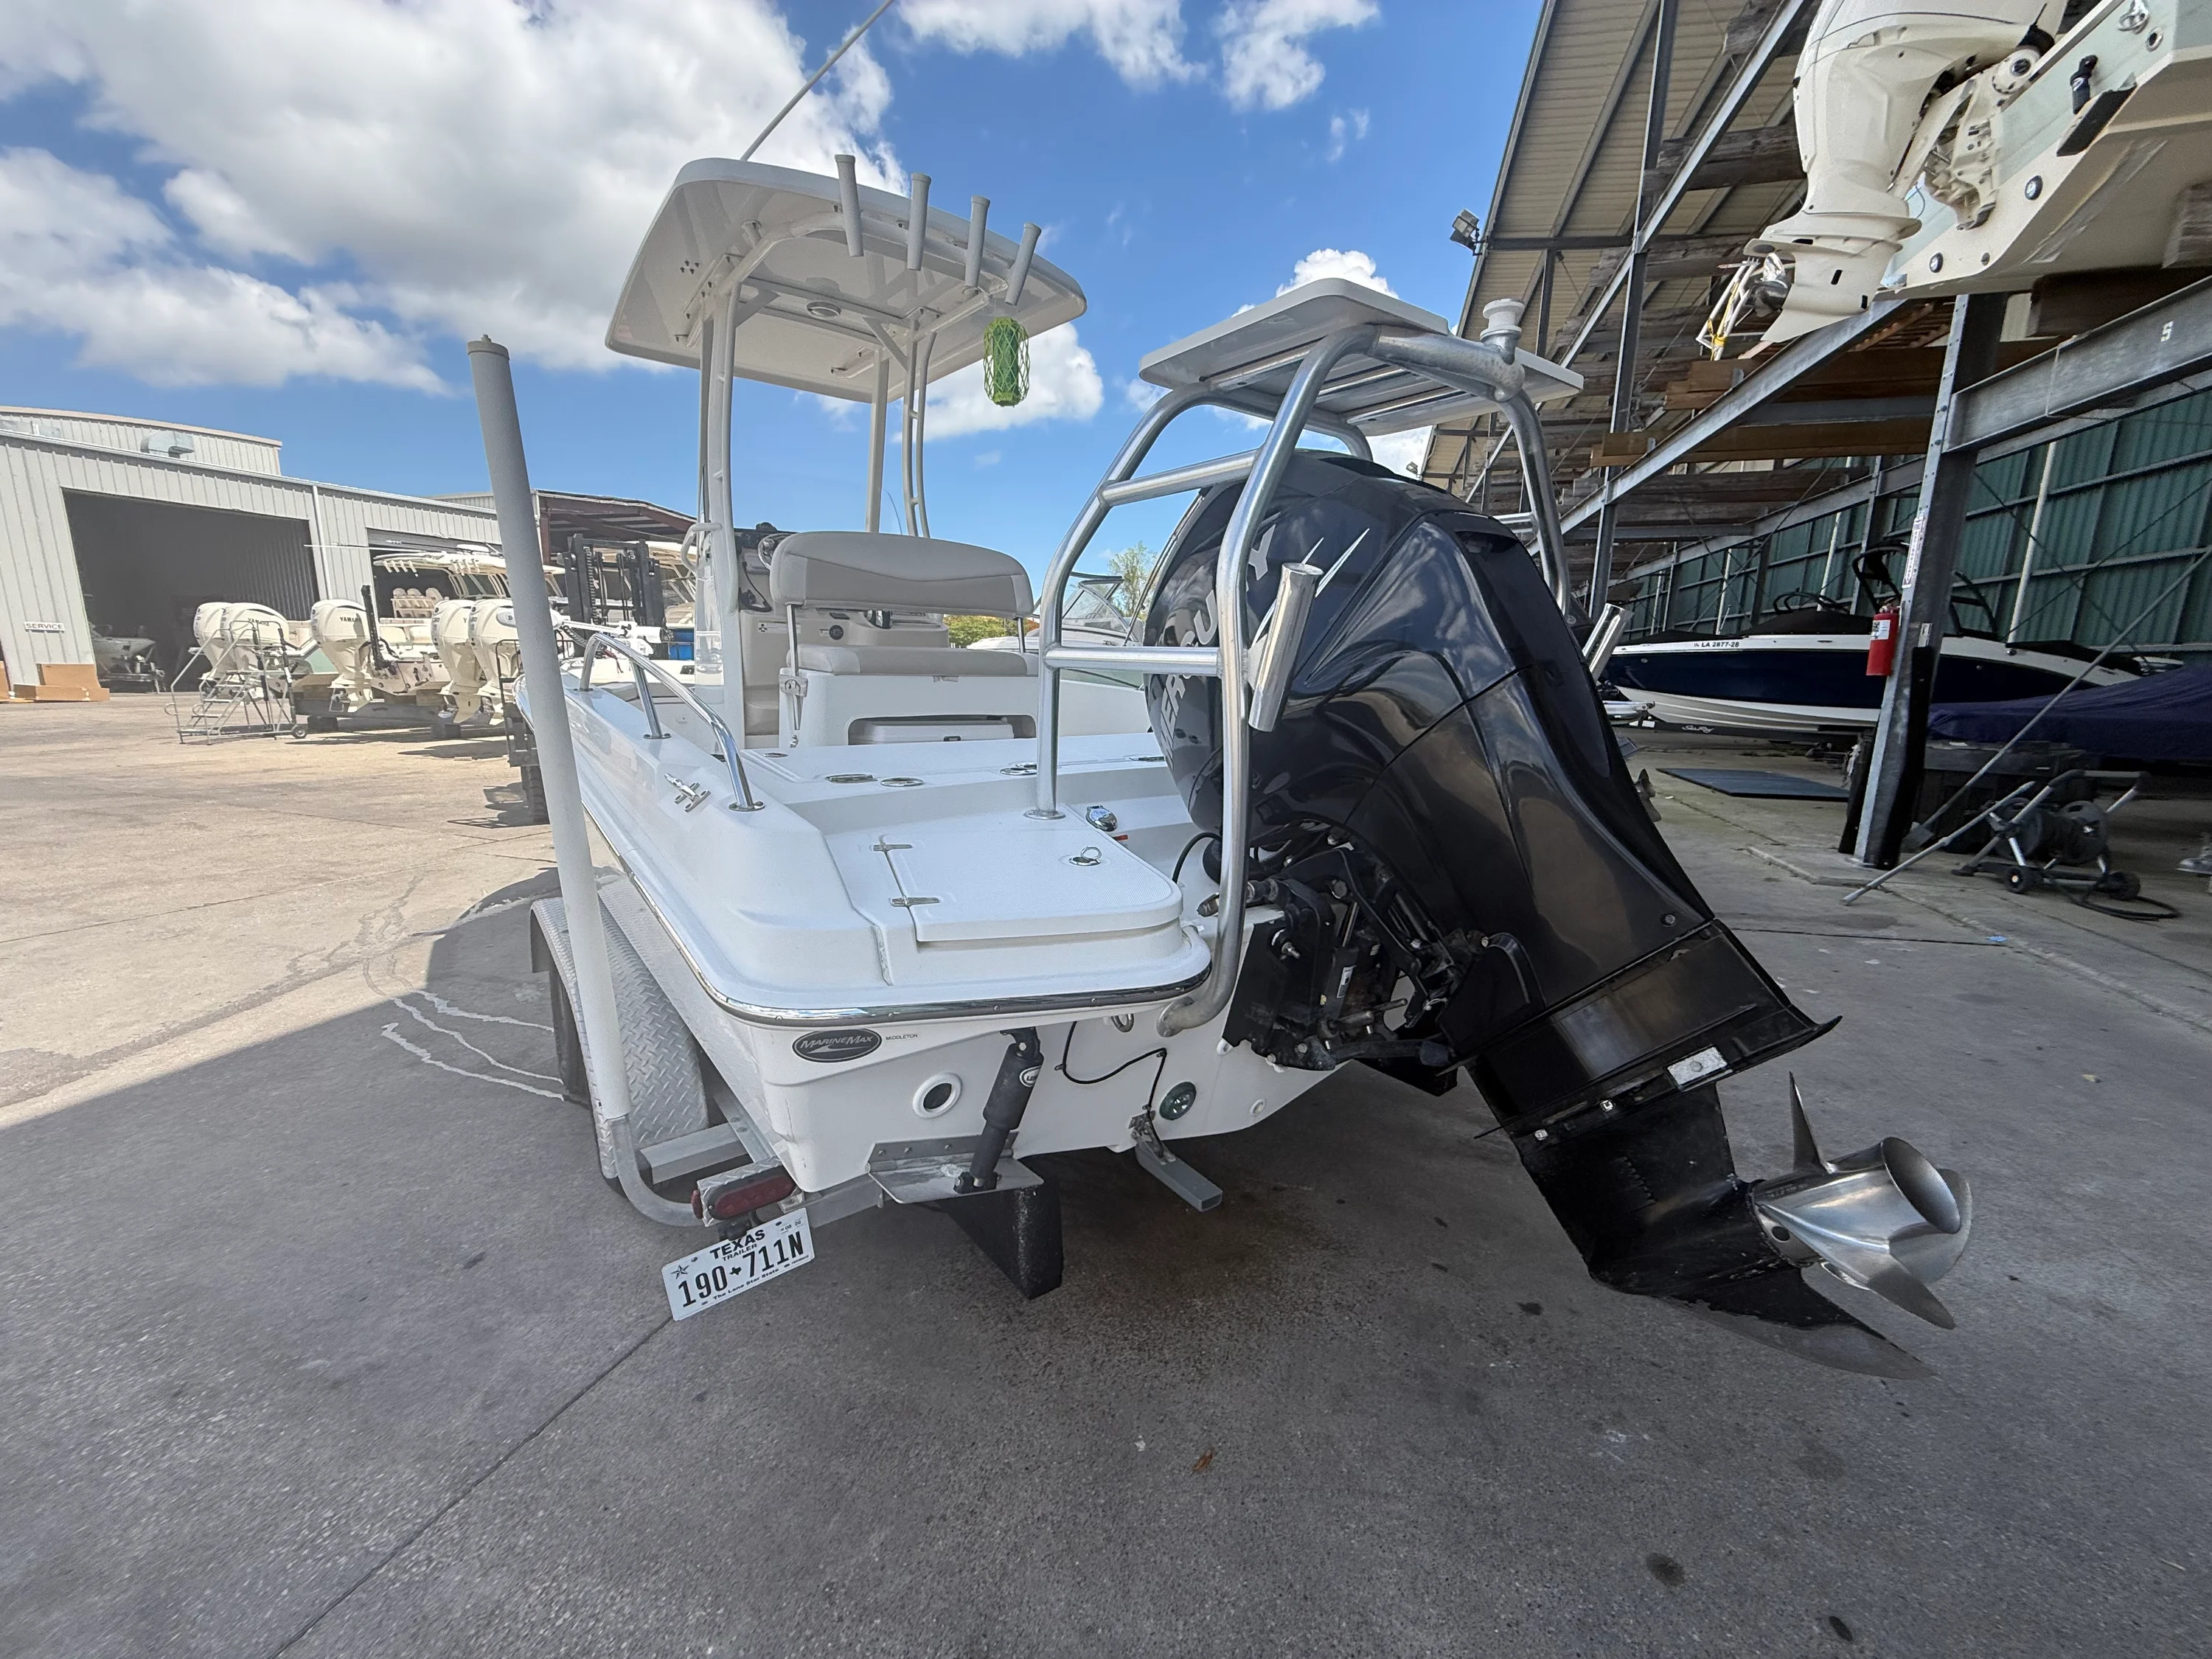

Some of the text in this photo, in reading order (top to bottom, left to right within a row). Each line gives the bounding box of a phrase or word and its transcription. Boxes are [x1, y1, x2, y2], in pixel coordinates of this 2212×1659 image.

[1160, 524, 1276, 771] MERUY
[709, 1229, 765, 1260] TEXAS
[722, 1243, 758, 1262] TRAILER
[678, 1231, 804, 1308] 190 711N
[713, 1268, 779, 1301] The Lone Star State
